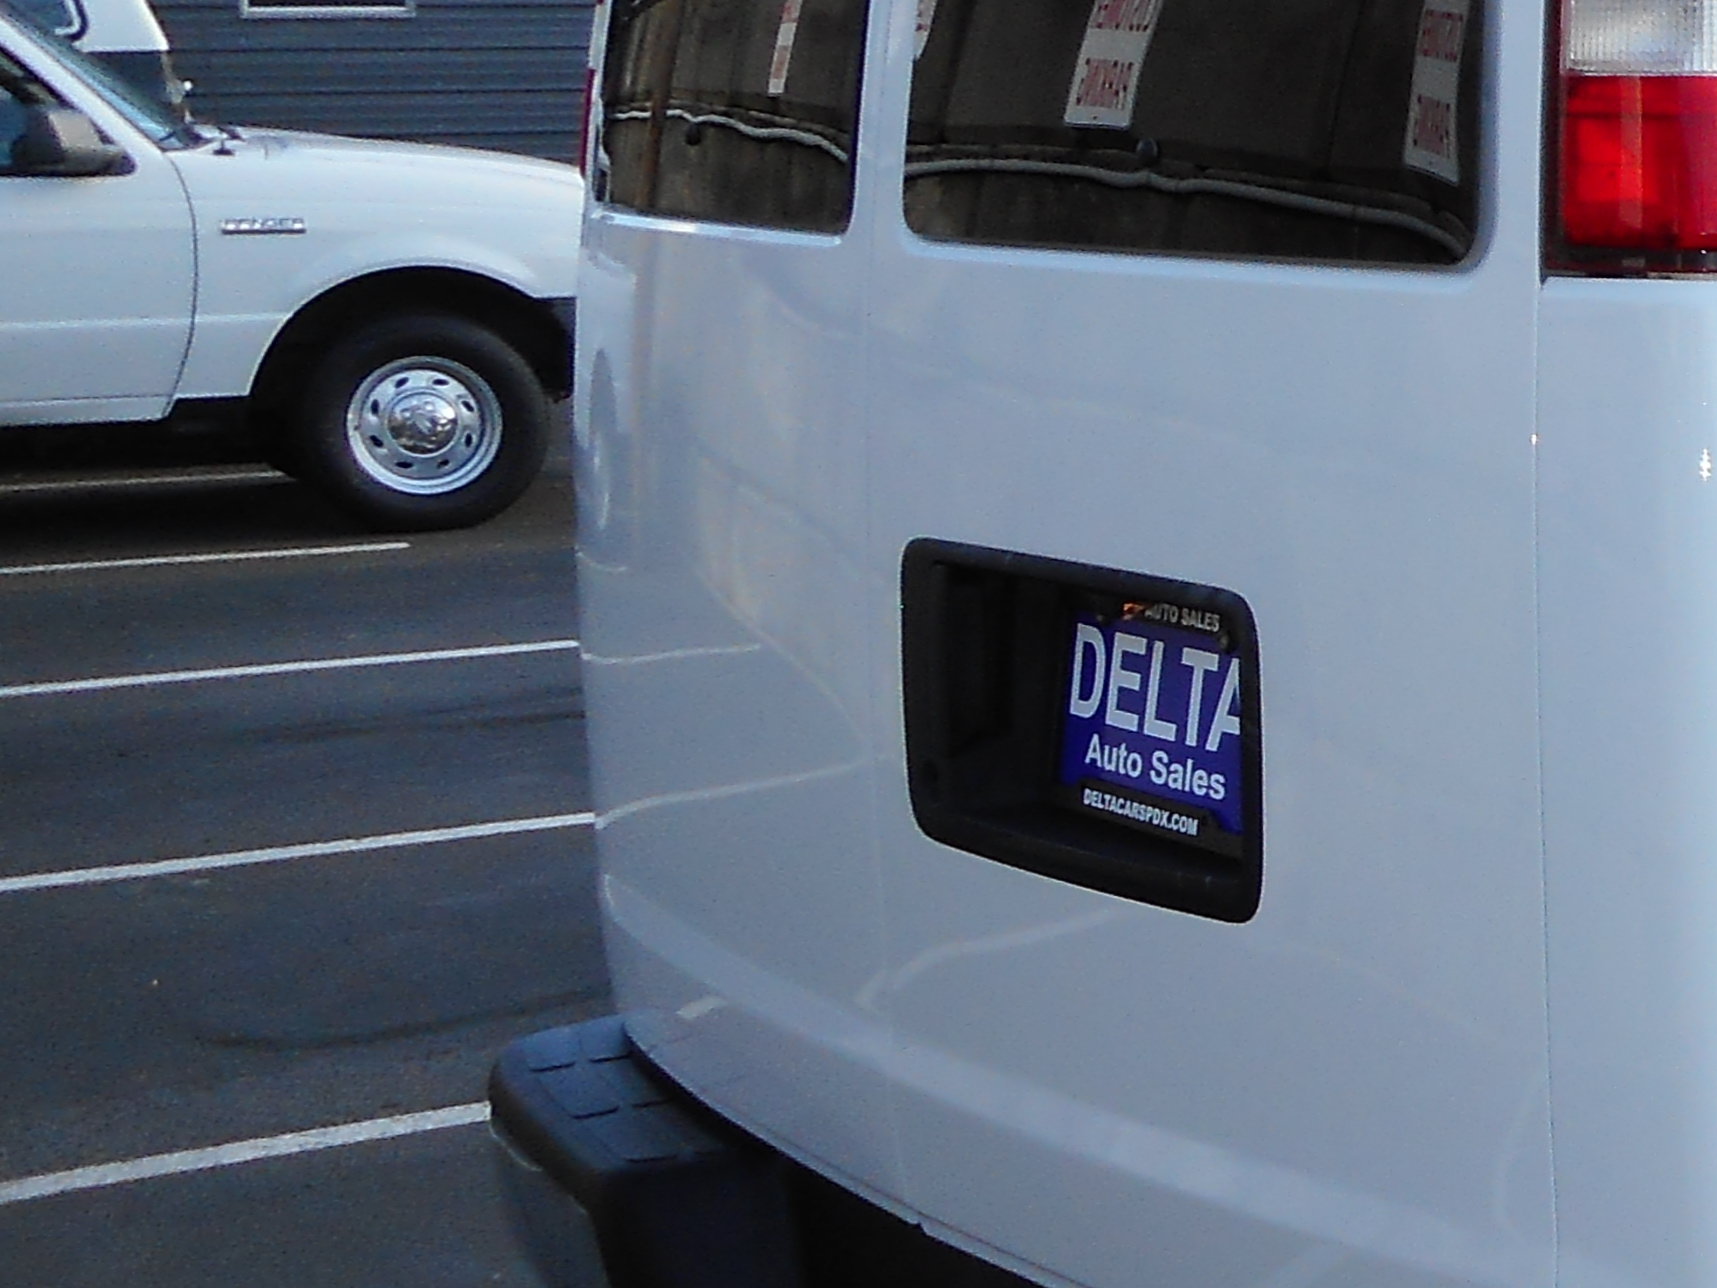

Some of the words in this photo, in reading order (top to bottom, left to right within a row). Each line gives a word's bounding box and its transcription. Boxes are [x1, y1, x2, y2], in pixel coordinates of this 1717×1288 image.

[1145, 603, 1179, 624] AUTO
[1180, 607, 1221, 632] SALES
[1069, 622, 1241, 752] DELTA
[1084, 733, 1143, 778] Auto
[1150, 750, 1226, 800] Sales
[1083, 787, 1199, 836] DELTACARSPDX.COM
